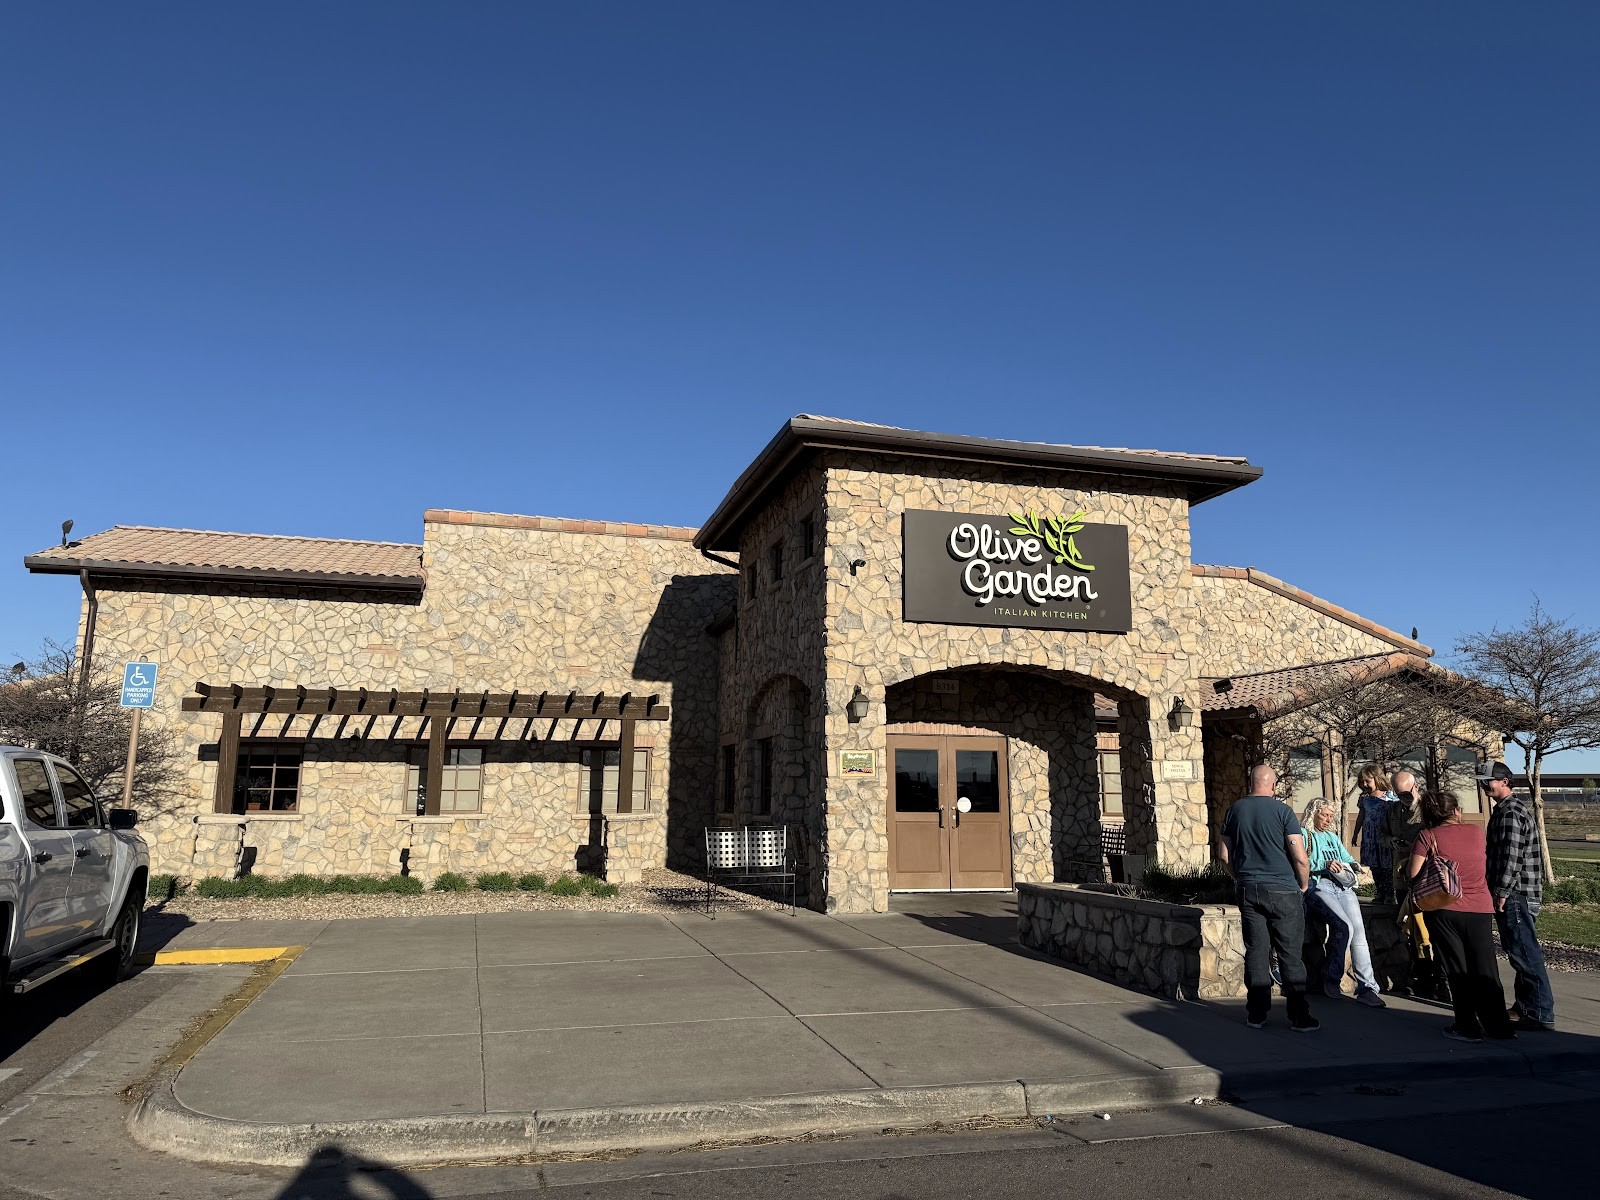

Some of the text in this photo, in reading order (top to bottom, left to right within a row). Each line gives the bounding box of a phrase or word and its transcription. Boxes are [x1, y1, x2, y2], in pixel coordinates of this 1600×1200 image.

[951, 523, 1042, 561] Olive
[965, 559, 1098, 603] Garden
[994, 608, 1088, 620] ITALIAN KITCHEN
